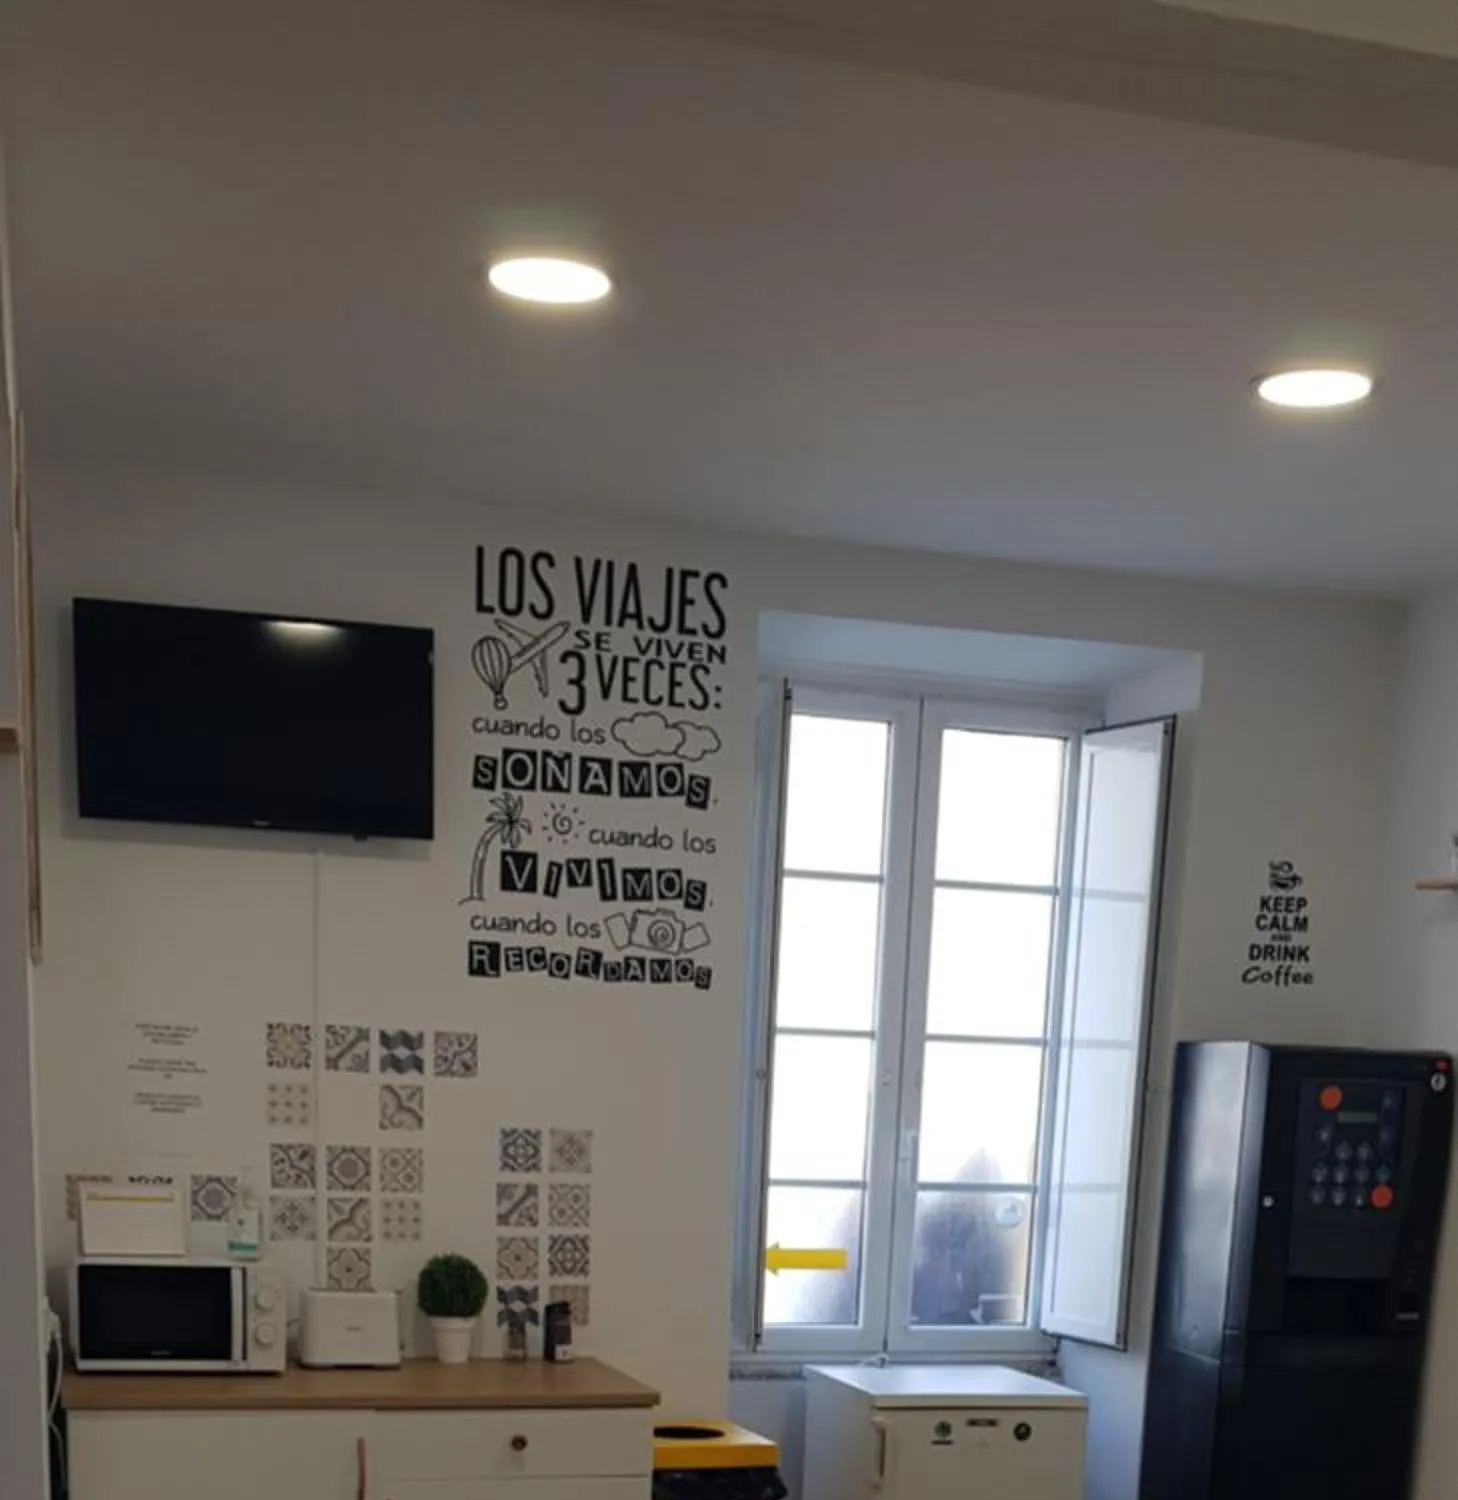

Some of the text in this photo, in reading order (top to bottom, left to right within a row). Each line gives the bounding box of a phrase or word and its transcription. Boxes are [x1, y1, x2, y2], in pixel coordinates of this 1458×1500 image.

[475, 545, 728, 639] LOS VIAJES
[574, 630, 726, 665] SE VIVEN
[558, 650, 722, 716] 3 VECES:
[471, 714, 606, 745] cuando los
[588, 826, 717, 854] cuando los
[1259, 895, 1308, 913] KEEP
[470, 912, 601, 938] cuando los
[1255, 913, 1309, 933] CALM
[468, 940, 712, 990] RECORDAMOS
[1248, 943, 1311, 963] DRINK
[1241, 964, 1314, 987] Coffee
